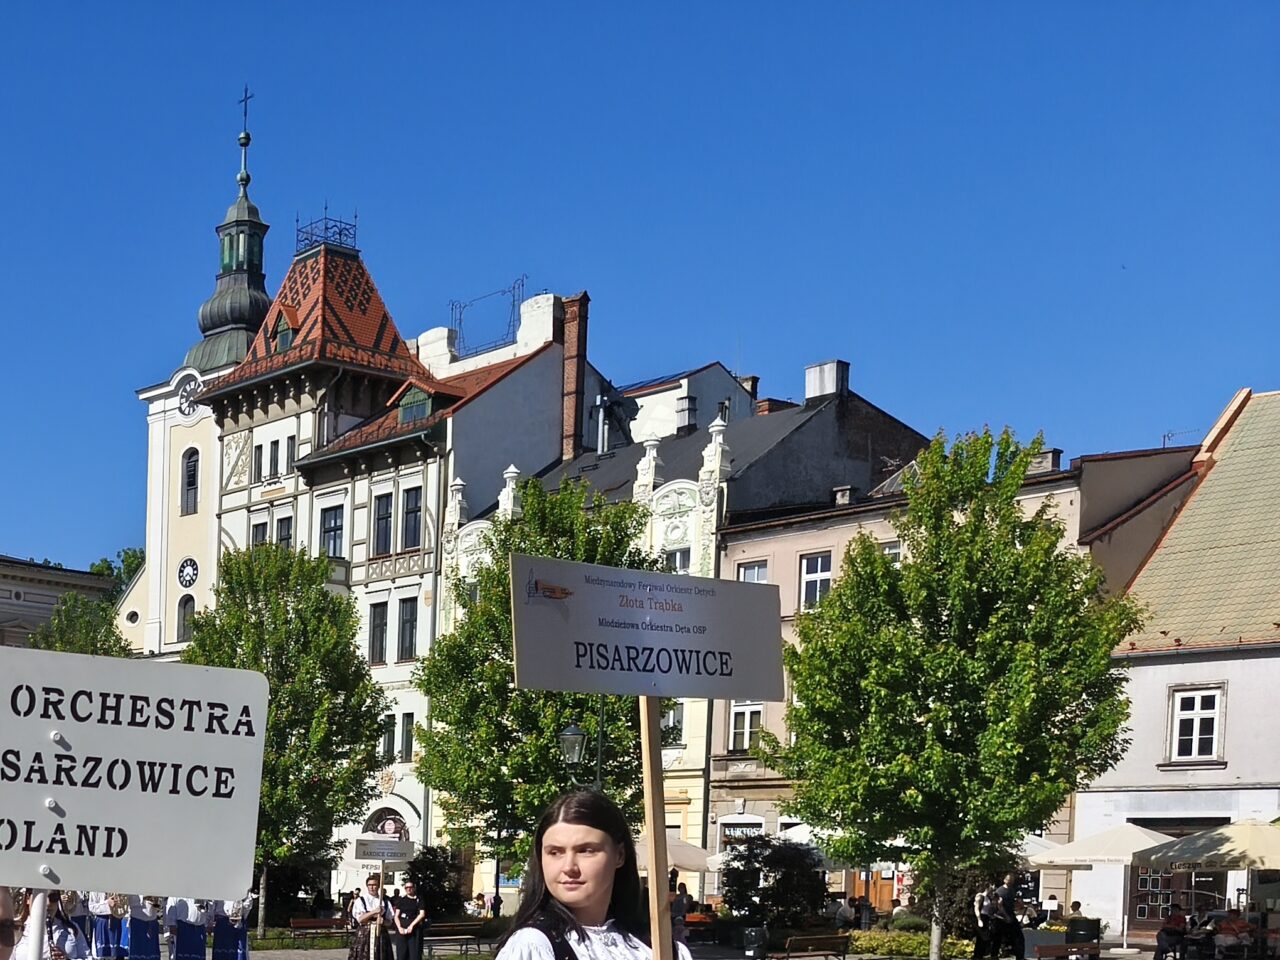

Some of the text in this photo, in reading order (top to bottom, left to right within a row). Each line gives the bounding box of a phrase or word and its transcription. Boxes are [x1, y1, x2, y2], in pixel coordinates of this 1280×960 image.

[619, 595, 684, 613] Złota Trąbka
[641, 621, 674, 633] Orkiestra
[675, 624, 691, 635] Dęta
[692, 625, 707, 635] OSP
[573, 641, 733, 677] PISARZOWICE
[10, 684, 256, 737] ORCHESTRA
